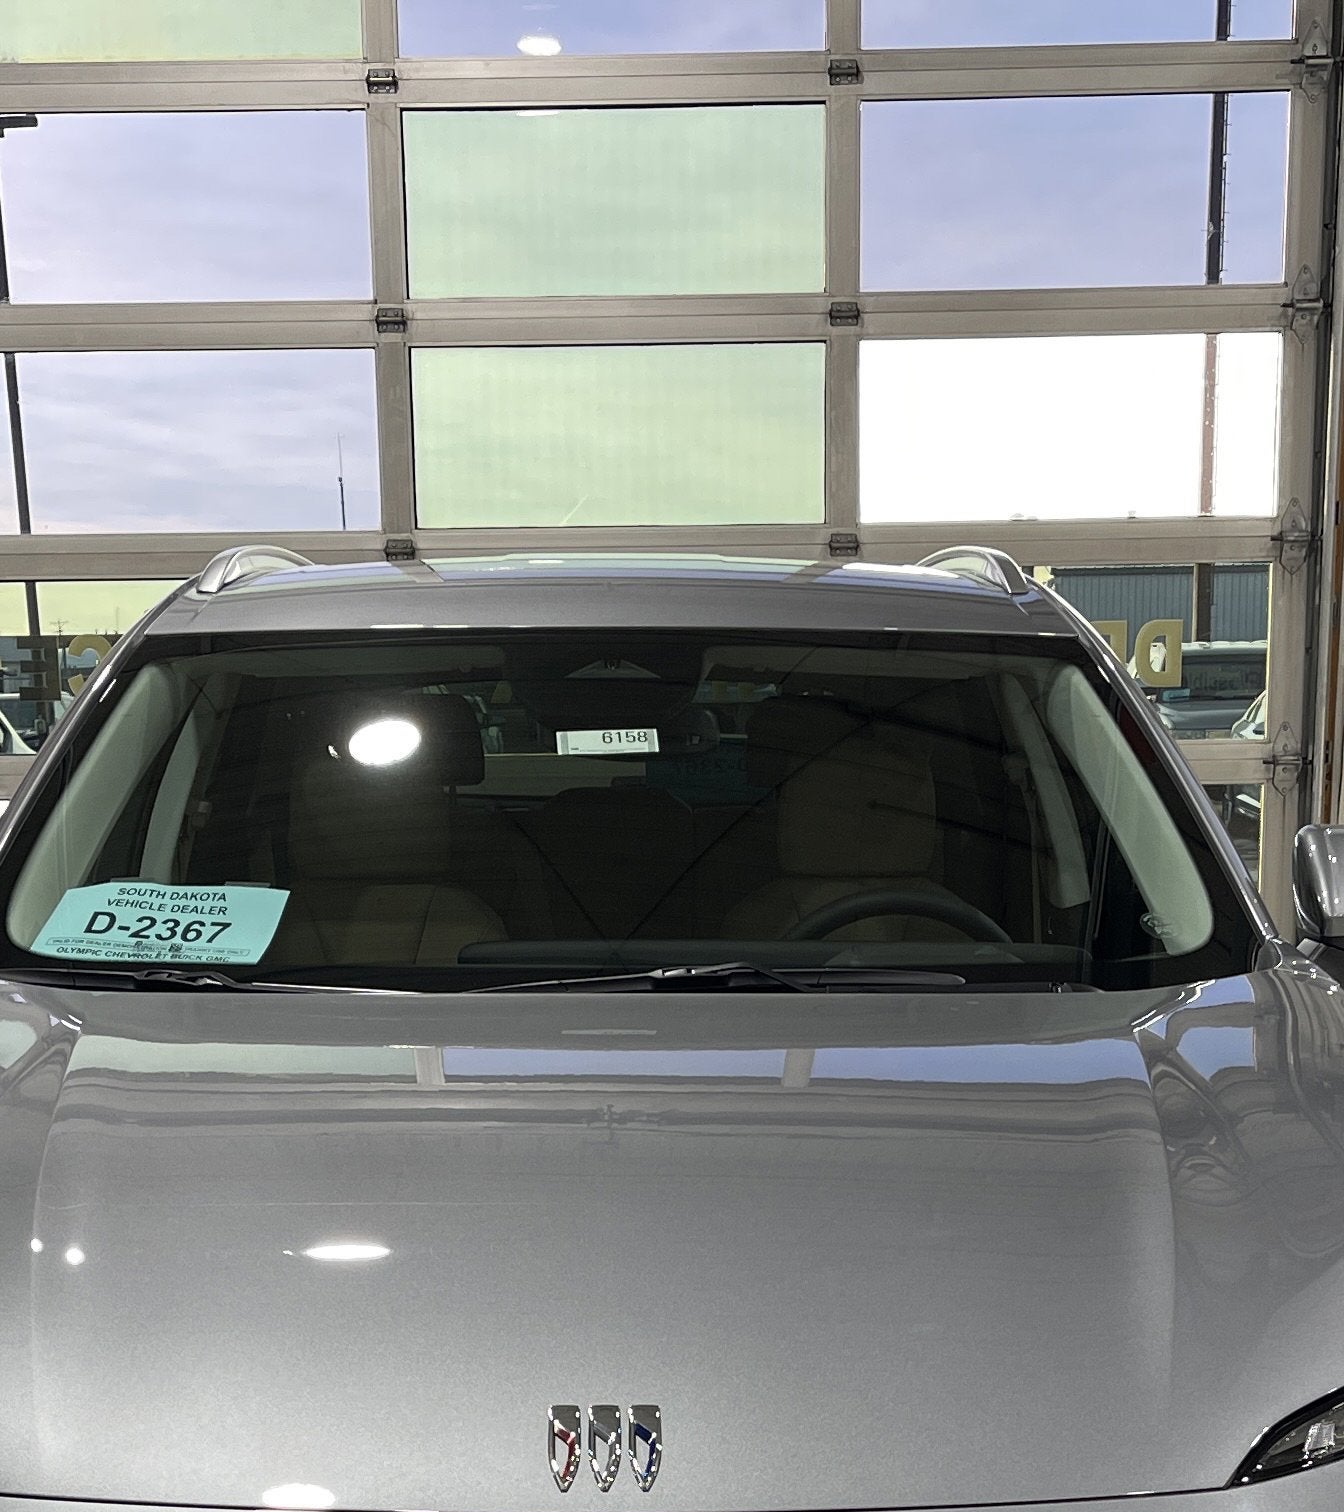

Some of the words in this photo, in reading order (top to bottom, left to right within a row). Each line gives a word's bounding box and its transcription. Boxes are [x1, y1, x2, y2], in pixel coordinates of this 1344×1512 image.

[602, 731, 649, 744] 6158
[117, 887, 167, 900] SOUTH
[169, 891, 227, 902] DAKOTA
[106, 898, 168, 912] VEHICLE
[170, 904, 228, 916] DEALER
[83, 911, 233, 944] D-2367
[56, 946, 102, 957] OLYMPIC
[104, 950, 168, 960] CHEVROLET
